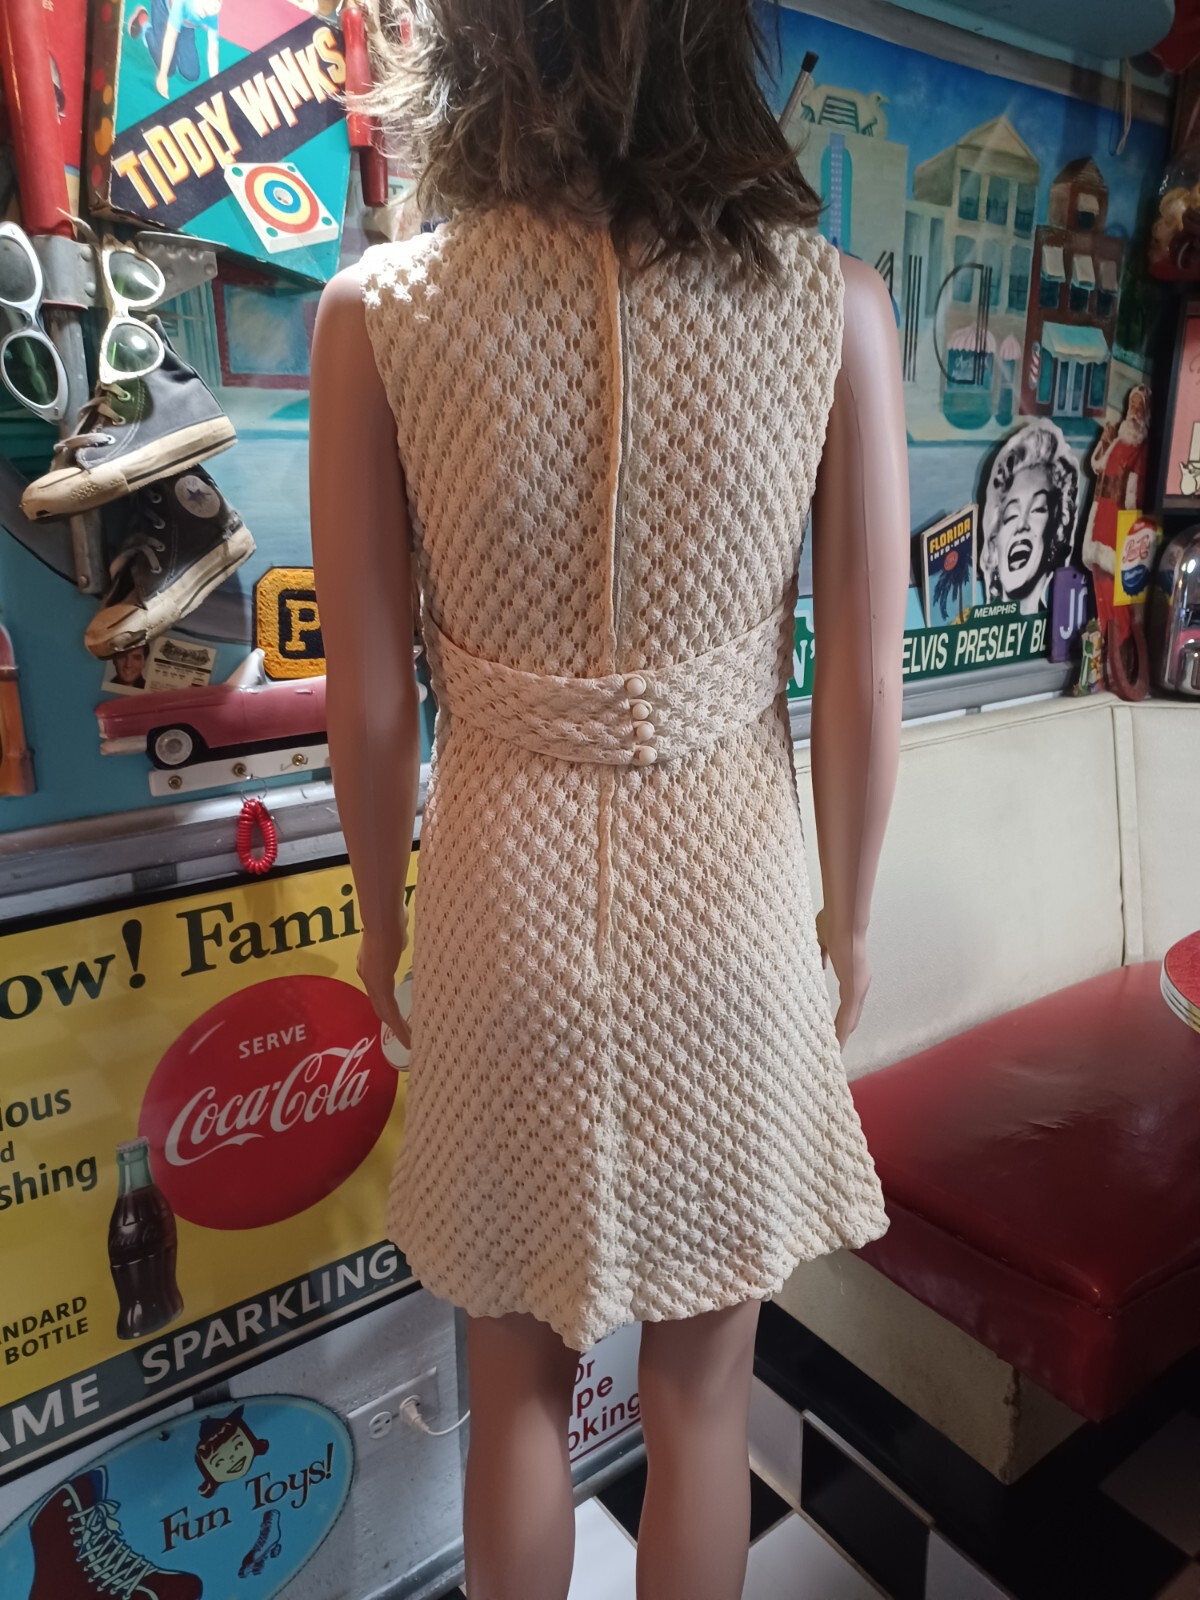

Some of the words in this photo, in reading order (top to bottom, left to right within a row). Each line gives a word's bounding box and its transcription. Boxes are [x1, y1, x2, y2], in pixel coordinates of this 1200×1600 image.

[229, 26, 346, 138] WINKS
[929, 518, 971, 553] FLORIDA
[285, 598, 321, 651] P
[974, 603, 1017, 618] MEMPHIS
[902, 632, 949, 674] ELVIS
[954, 621, 1027, 666] PRESLEY
[238, 1024, 307, 1060] SERVE
[165, 1034, 377, 1167] Coca-Cola
[0, 1296, 87, 1345] NDARD
[141, 1244, 399, 1385] SPARKLING
[4, 1317, 89, 1366] BOTTLE
[160, 1505, 232, 1552] Fun
[245, 1442, 334, 1509] Toys!
